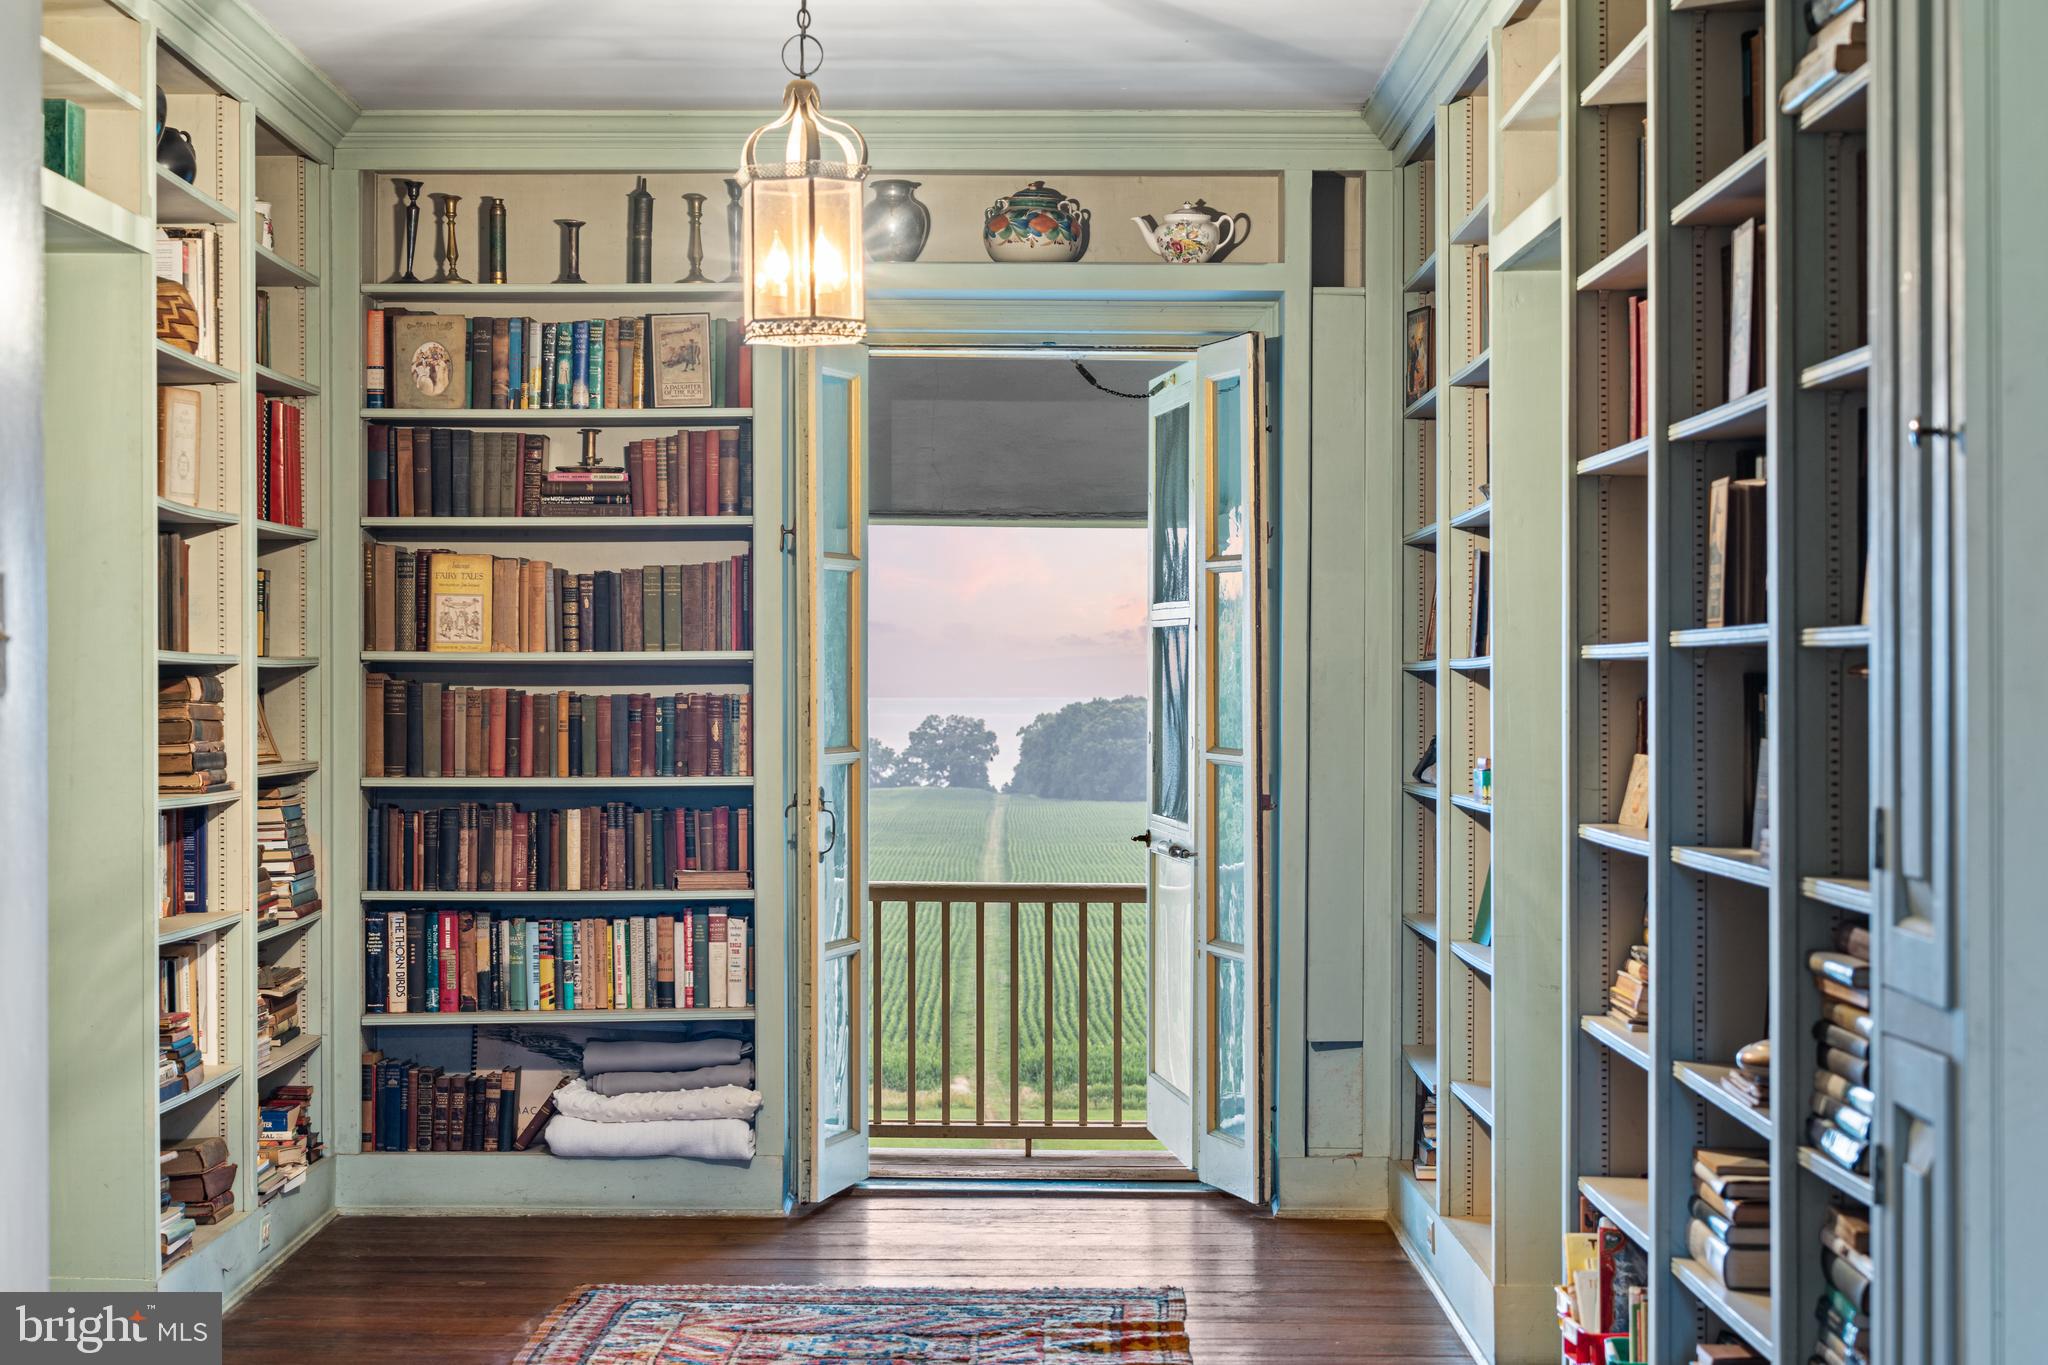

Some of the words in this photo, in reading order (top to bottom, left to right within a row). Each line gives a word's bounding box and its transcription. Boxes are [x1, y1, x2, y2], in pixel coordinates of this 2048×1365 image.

[435, 572, 457, 580] FAIRY
[461, 572, 484, 580] TALES
[395, 917, 405, 933] THE
[395, 936, 406, 970] THORN
[440, 949, 457, 990] Memoirs
[395, 971, 406, 998] BIRDS
